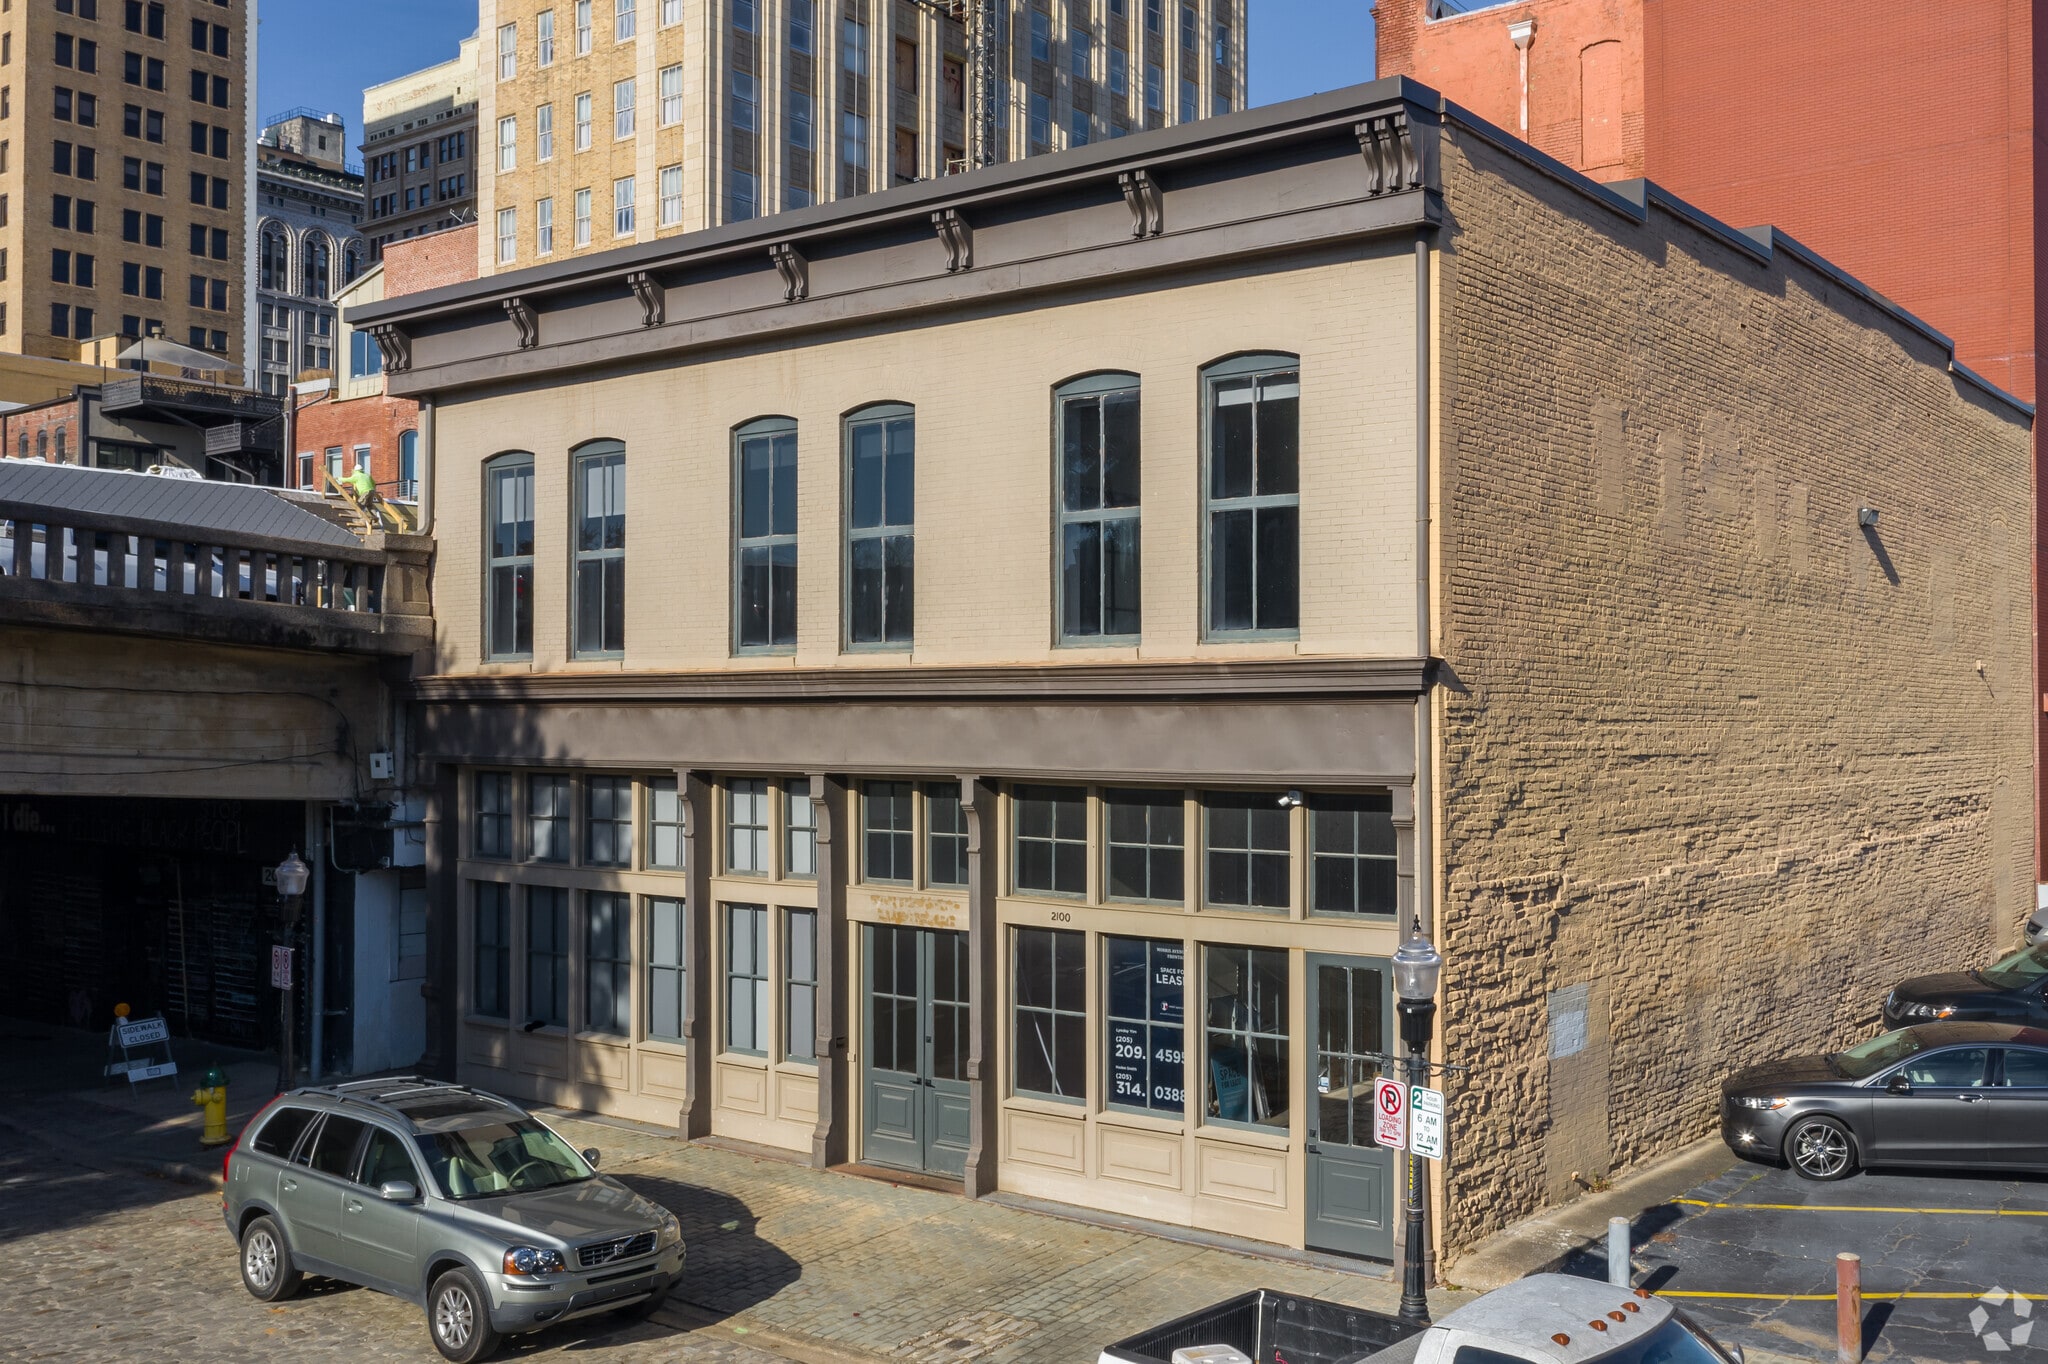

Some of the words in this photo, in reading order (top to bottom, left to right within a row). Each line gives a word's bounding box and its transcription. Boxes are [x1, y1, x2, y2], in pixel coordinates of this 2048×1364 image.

[1051, 911, 1071, 923] 2100
[1160, 967, 1176, 975] SPACE
[122, 1021, 163, 1035] SIDEWALK
[128, 1031, 161, 1043] CLOSED
[1115, 1035, 1133, 1044] (205)
[1115, 1044, 1146, 1060] 209.
[1115, 1072, 1133, 1081] (205)
[1116, 1081, 1146, 1097] 314.
[1413, 1091, 1422, 1107] 2
[1378, 1112, 1402, 1124] LOADING
[1417, 1113, 1423, 1123] 6
[1425, 1116, 1437, 1126] AM
[1382, 1121, 1398, 1131] ZONE
[1416, 1132, 1424, 1142] 12
[1426, 1135, 1438, 1145] AM
